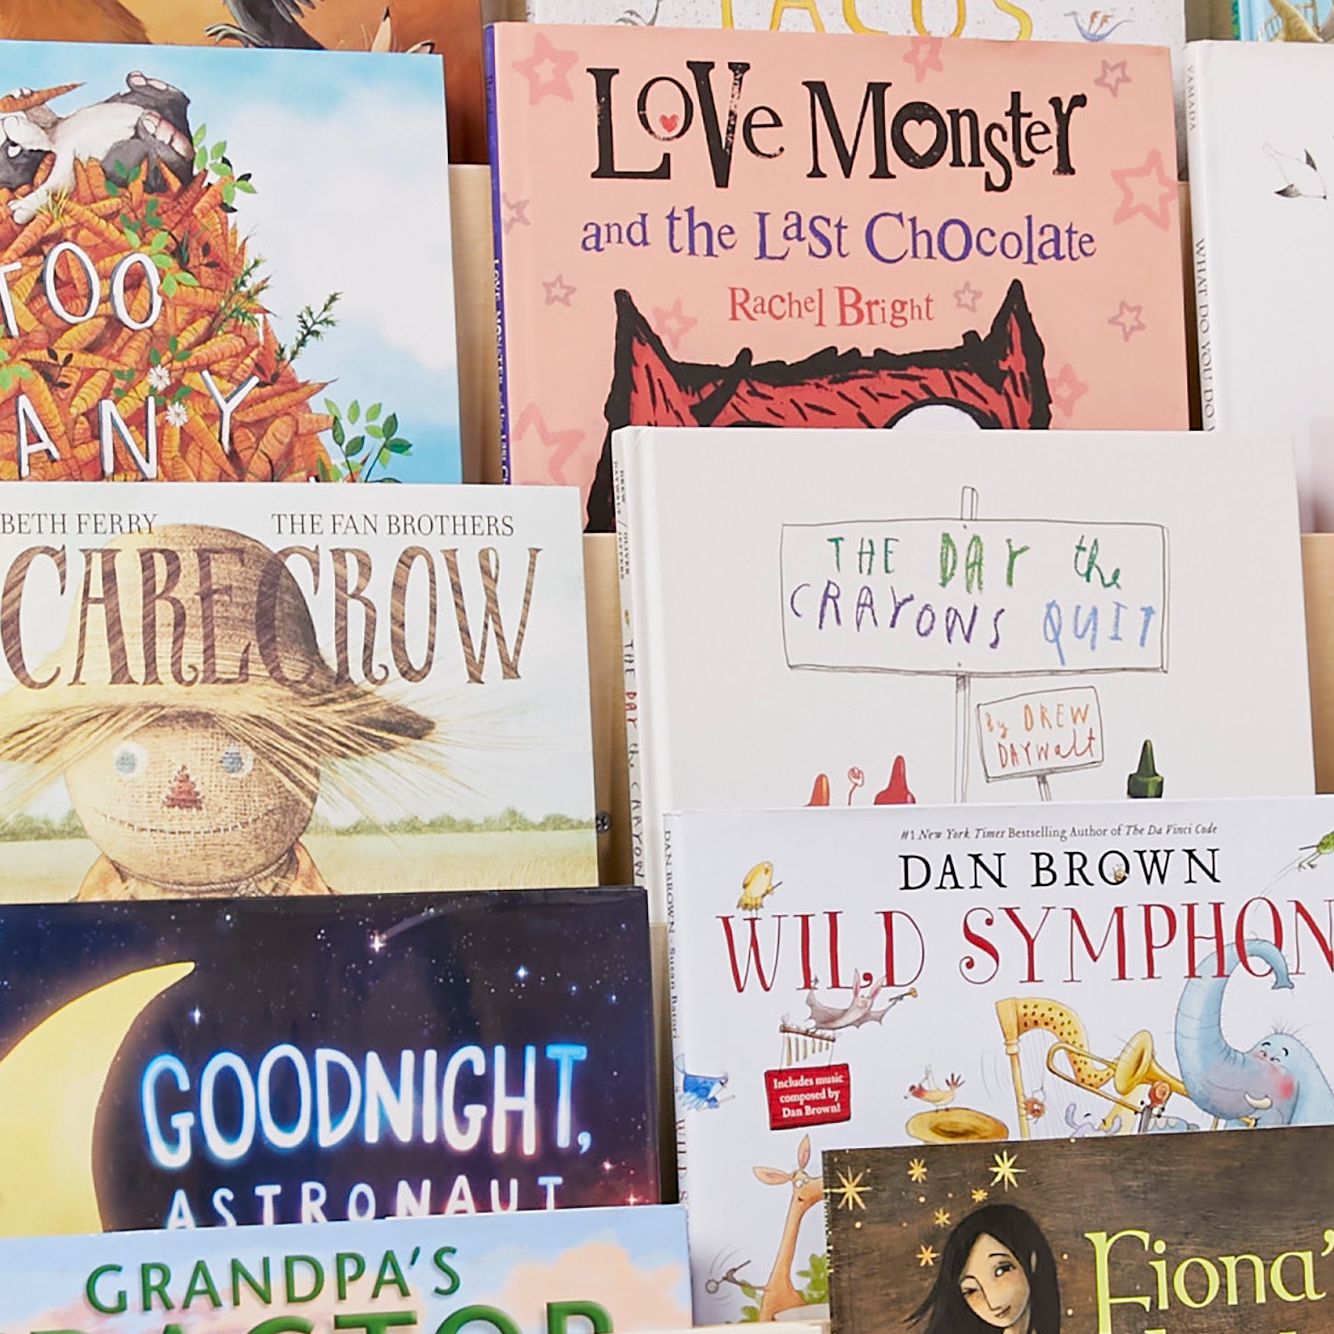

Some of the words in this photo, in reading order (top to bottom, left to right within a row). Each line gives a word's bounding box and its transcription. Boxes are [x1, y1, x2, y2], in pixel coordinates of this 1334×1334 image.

[1186, 65, 1197, 131] YAMADA
[580, 212, 650, 253] and
[665, 205, 737, 258] the
[754, 208, 849, 261] Last
[1195, 238, 1208, 297] WHAT
[727, 286, 825, 328] Rachel
[836, 286, 935, 331] Bright
[1198, 304, 1210, 334] DO
[1200, 341, 1213, 380] YOU
[1203, 388, 1215, 419] DO
[0, 513, 70, 536] BETH
[76, 513, 158, 536] FERRY
[272, 513, 326, 536] THE
[332, 513, 381, 536] FAN
[386, 514, 515, 537] BROTHERS
[827, 536, 899, 575] THE
[938, 531, 1031, 593] DAY
[1074, 534, 1123, 590] the
[790, 578, 1006, 649] CRAYONS
[1043, 598, 1157, 666] QUIT
[1023, 703, 1089, 732] DREW
[900, 829, 915, 841] #1
[918, 829, 942, 840] New
[946, 828, 970, 840] York
[974, 827, 1005, 839] Times
[1008, 826, 1067, 842] Bestselling
[1069, 825, 1108, 838] Author
[1110, 824, 1122, 837] of
[1125, 824, 1144, 836] The
[1147, 824, 1163, 836] Da
[1165, 823, 1192, 835] Vinci
[1195, 822, 1218, 835] Code
[898, 852, 1007, 891] DAN
[1030, 848, 1221, 888] BROWN
[716, 908, 926, 994] WILD
[773, 1074, 814, 1090] Includes
[815, 1071, 844, 1085] music
[779, 1087, 826, 1106] composed
[827, 1087, 841, 1102] by
[782, 1107, 803, 1118] Dan
[804, 1102, 841, 1116] Brown!
[166, 1174, 565, 1230] ASTRONAUT
[85, 1245, 463, 1315] GRANDPA'S
